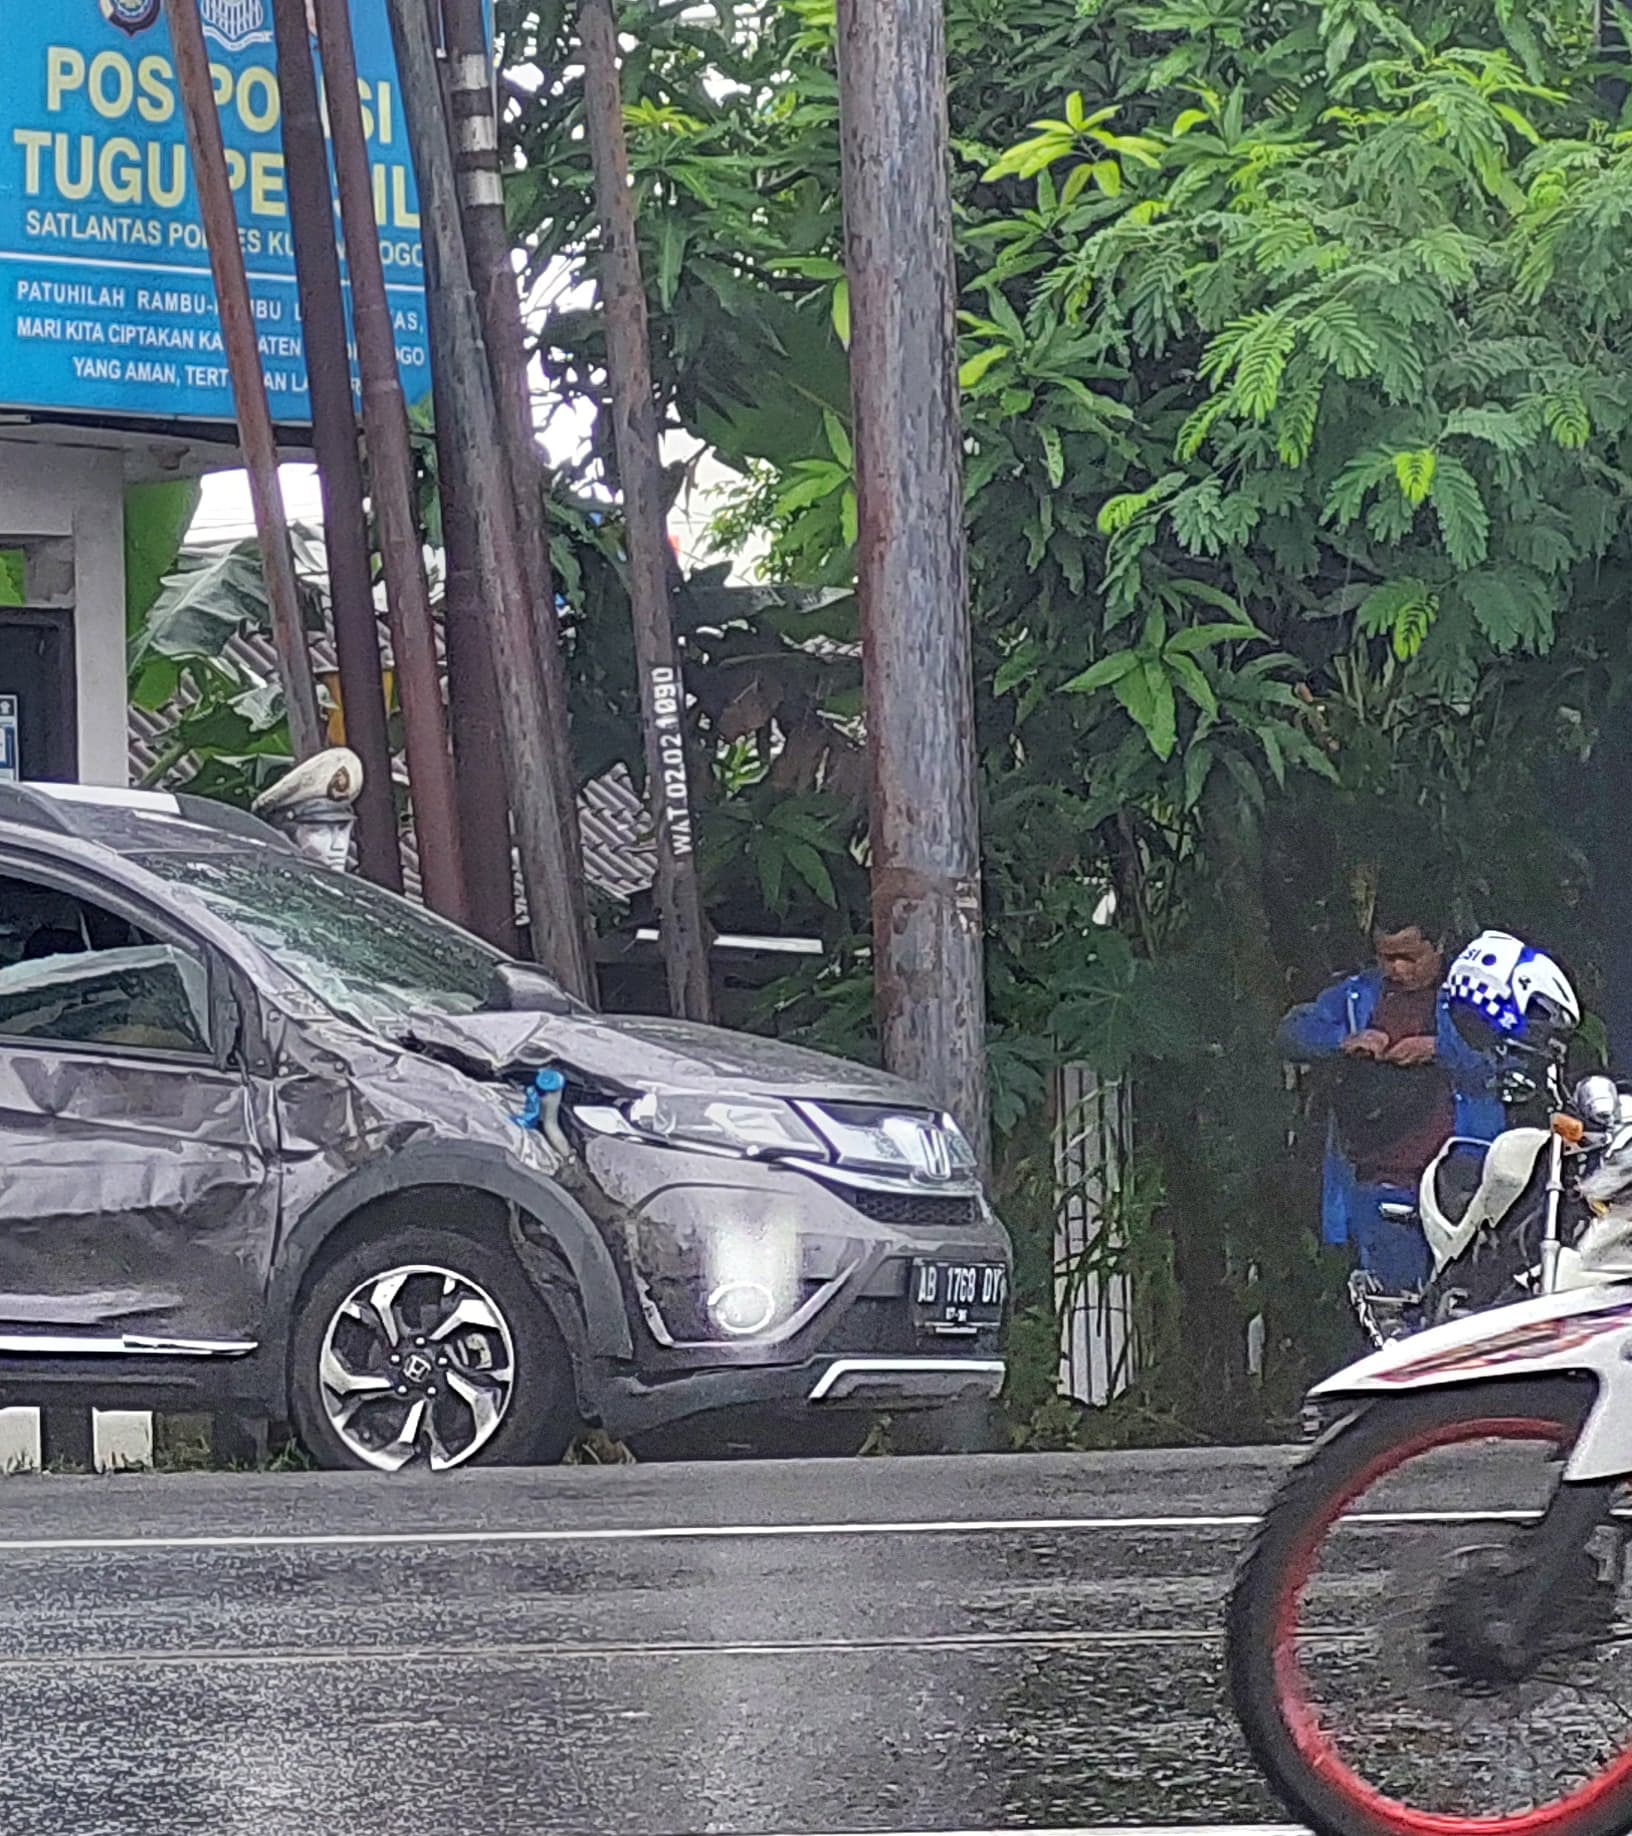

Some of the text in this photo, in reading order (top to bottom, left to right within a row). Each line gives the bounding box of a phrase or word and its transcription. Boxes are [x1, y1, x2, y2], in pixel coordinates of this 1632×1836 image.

[47, 46, 174, 122] POS
[14, 128, 185, 208] TUGU
[26, 210, 162, 246] SATLANTAS
[18, 280, 125, 308] PATUHILAH
[18, 316, 301, 356] MARI KITA CIPTAKAN KAATEN
[73, 356, 121, 379] YANG
[125, 360, 181, 387] AMAN,
[185, 365, 229, 387] TERT
[667, 806, 693, 856] WAT
[918, 1266, 937, 1303] AB
